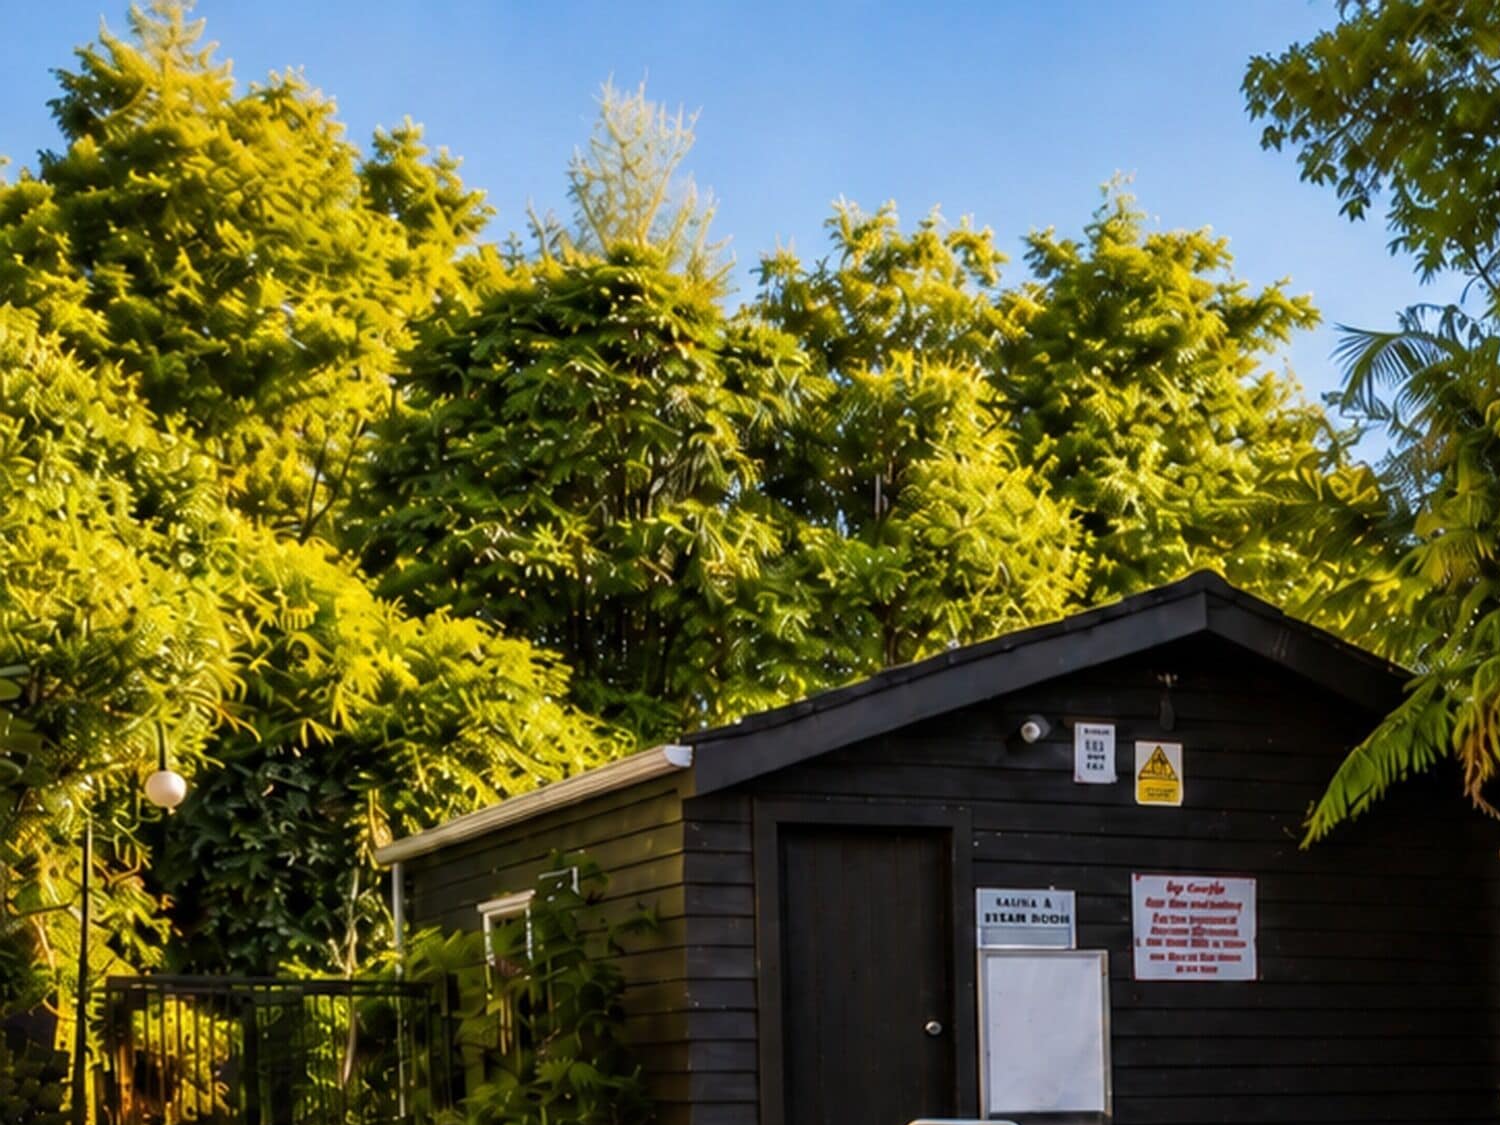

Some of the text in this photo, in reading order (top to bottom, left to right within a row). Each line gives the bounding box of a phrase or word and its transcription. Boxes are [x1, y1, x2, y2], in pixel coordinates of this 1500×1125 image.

[996, 897, 1037, 908] SAUNA
[985, 912, 1070, 924] STEAM ROOM
